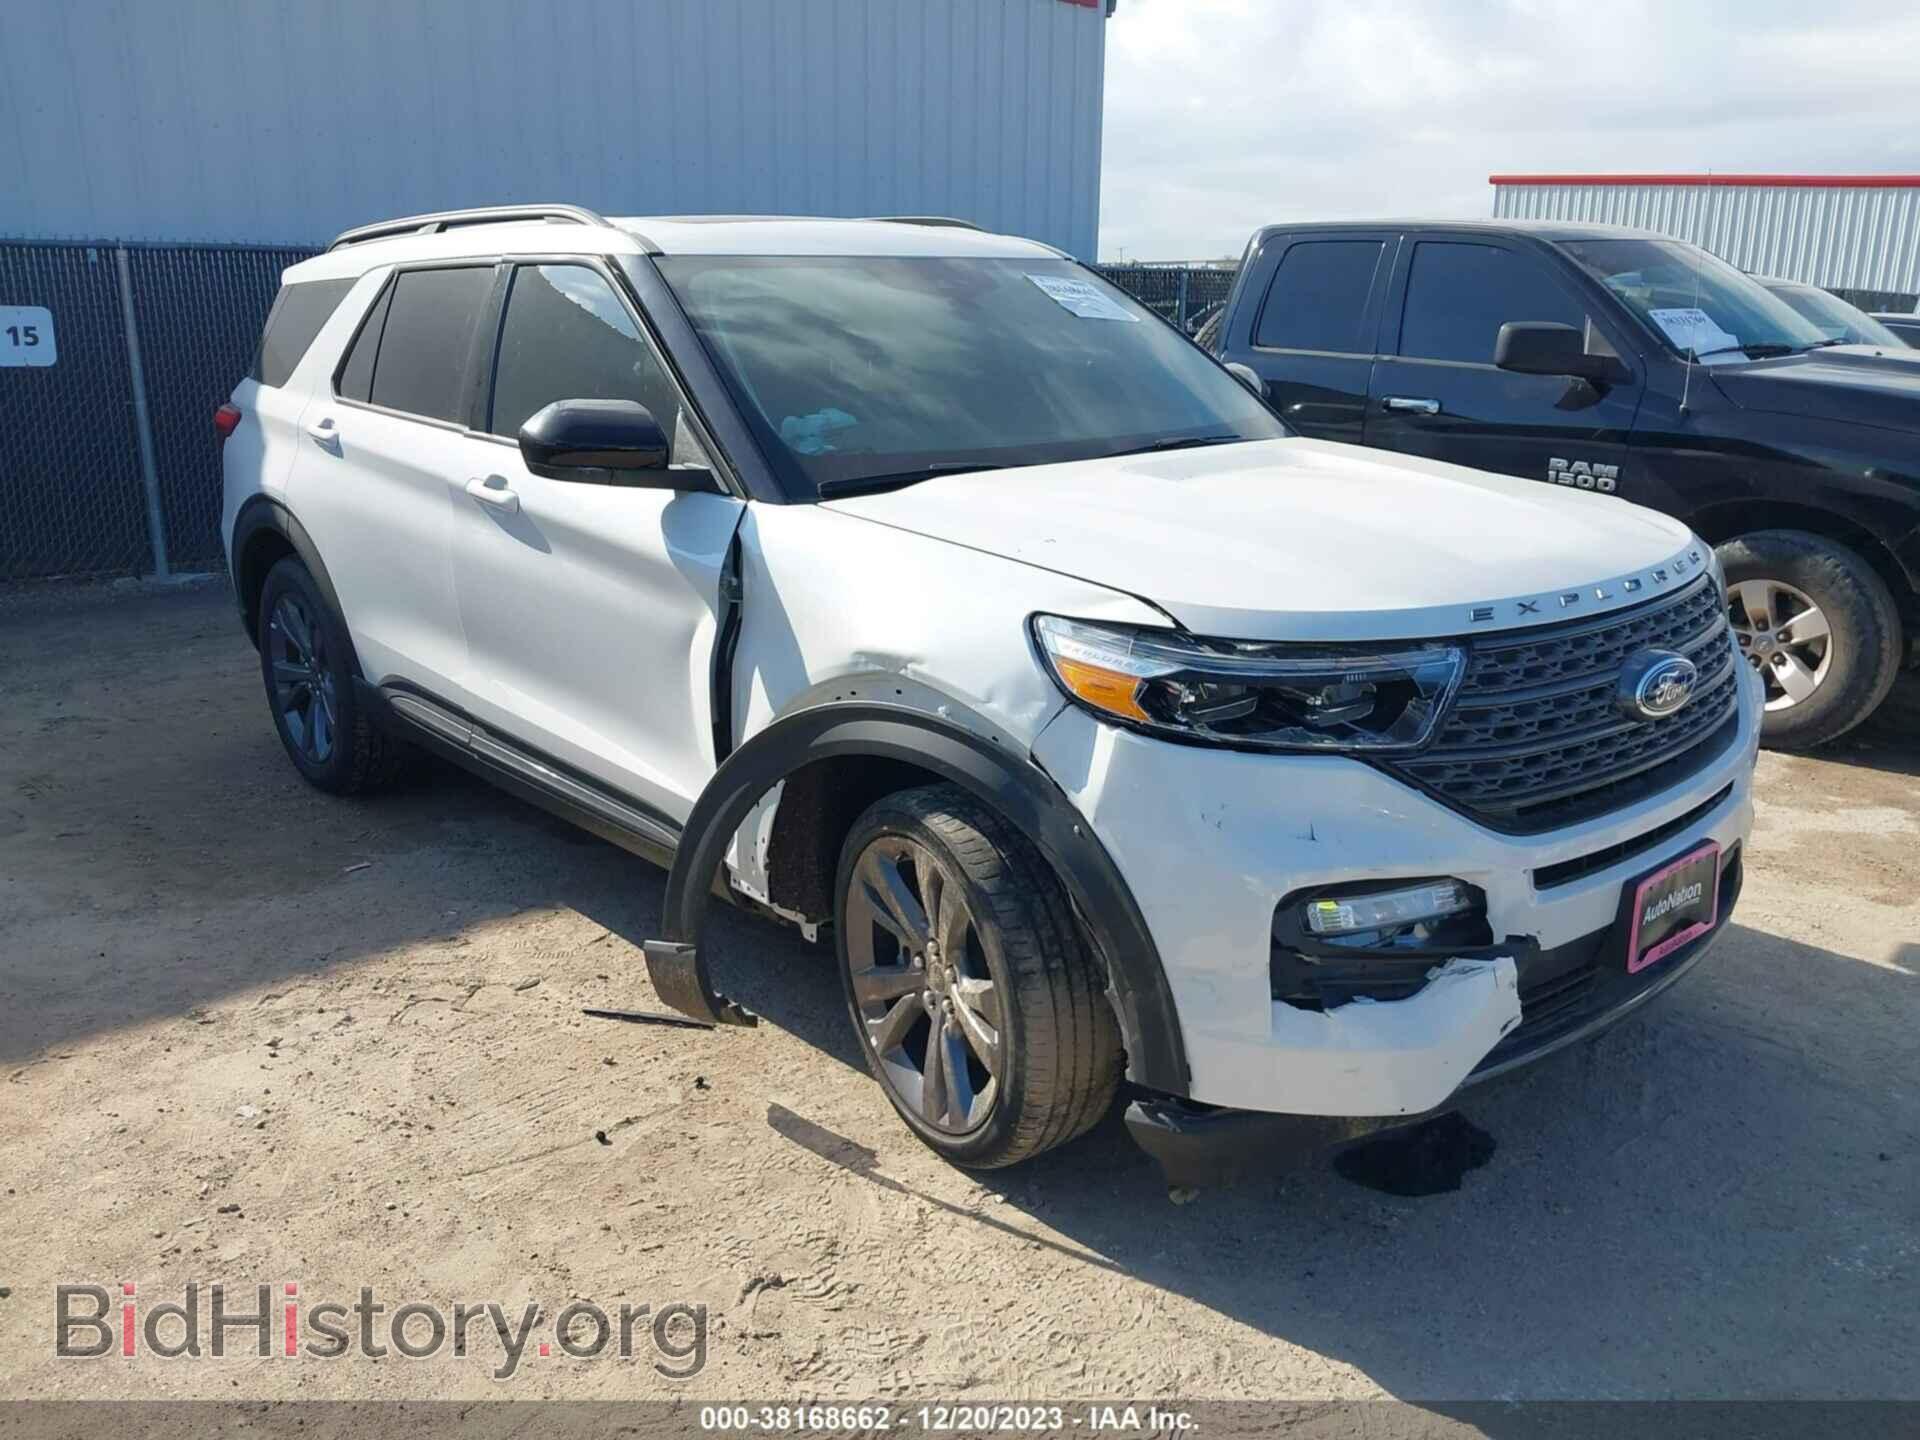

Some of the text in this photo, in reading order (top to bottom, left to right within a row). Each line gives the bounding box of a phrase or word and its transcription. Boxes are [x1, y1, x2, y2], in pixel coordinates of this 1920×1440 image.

[5, 325, 40, 347] 15
[1548, 457, 1619, 478] RAM
[1547, 470, 1616, 492] 1500
[1469, 551, 1700, 622] EXPLORER
[1642, 882, 1702, 926] AutoNation
